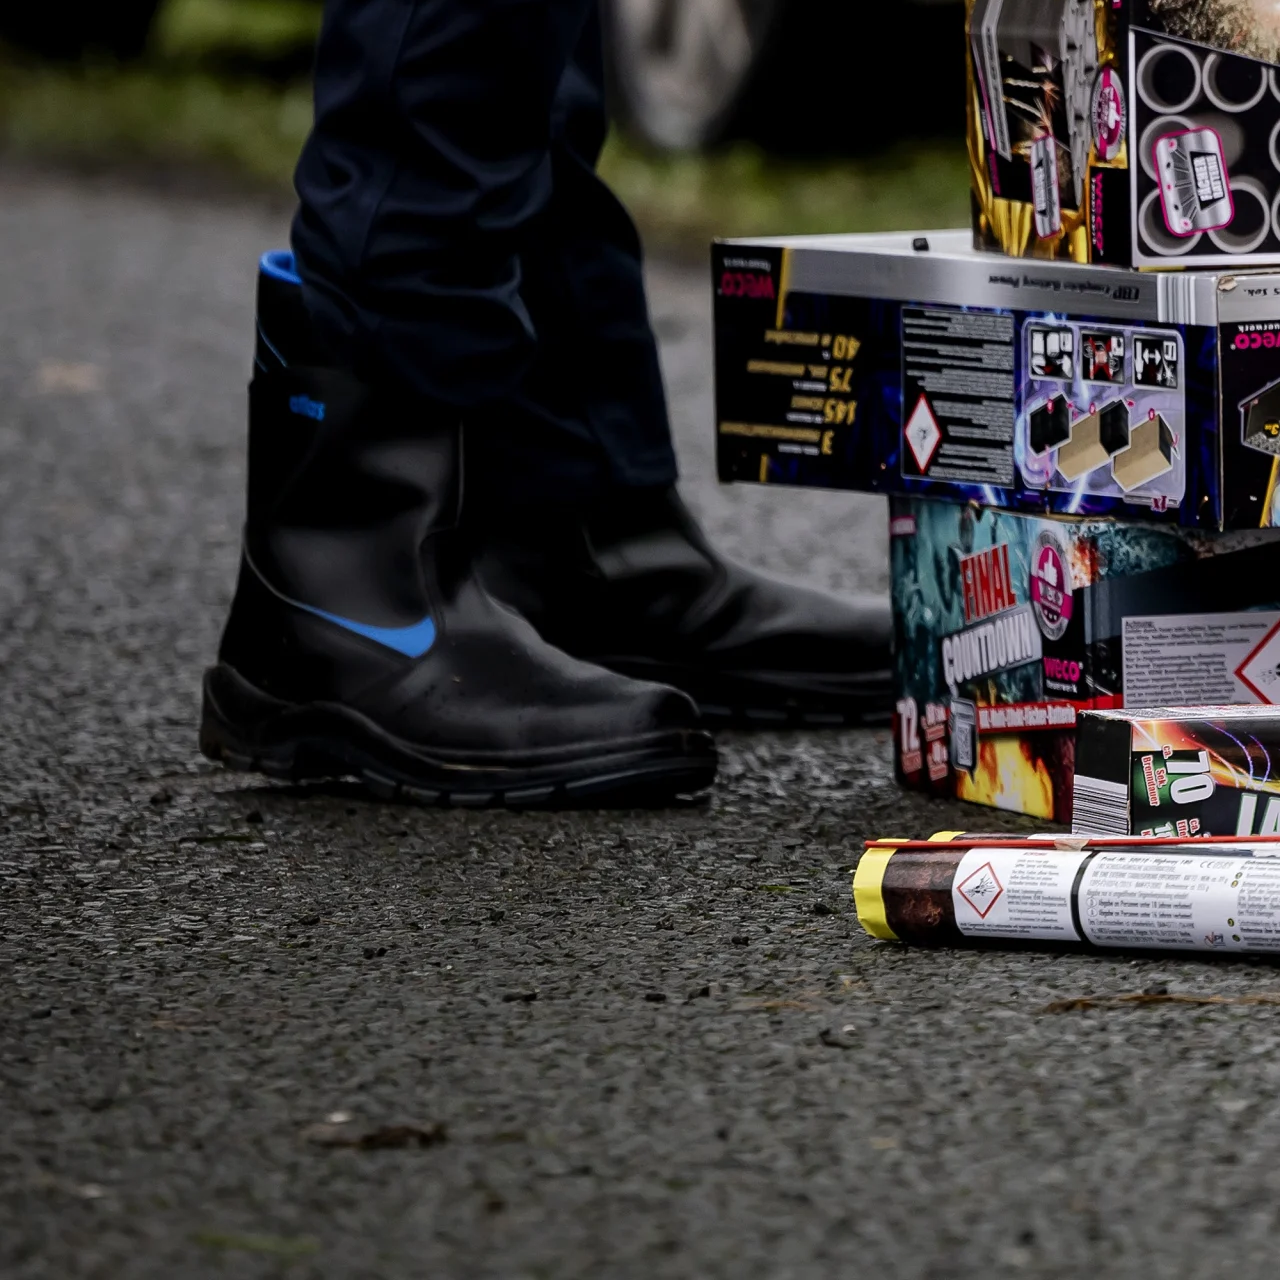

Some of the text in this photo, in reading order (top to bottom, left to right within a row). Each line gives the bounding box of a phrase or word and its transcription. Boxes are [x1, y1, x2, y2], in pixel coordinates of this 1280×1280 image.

[1243, 288, 1268, 296] Sek.
[832, 334, 861, 361] 40
[829, 366, 853, 392] 75
[824, 398, 857, 425] 145
[960, 543, 1017, 623] FINAL
[942, 610, 1034, 690] COUNTDOWN
[1044, 656, 1081, 682] weco
[1162, 744, 1173, 759] ca.
[1141, 755, 1160, 807] Brenndauer
[1155, 768, 1168, 789] Sek.
[1166, 750, 1216, 804] 10
